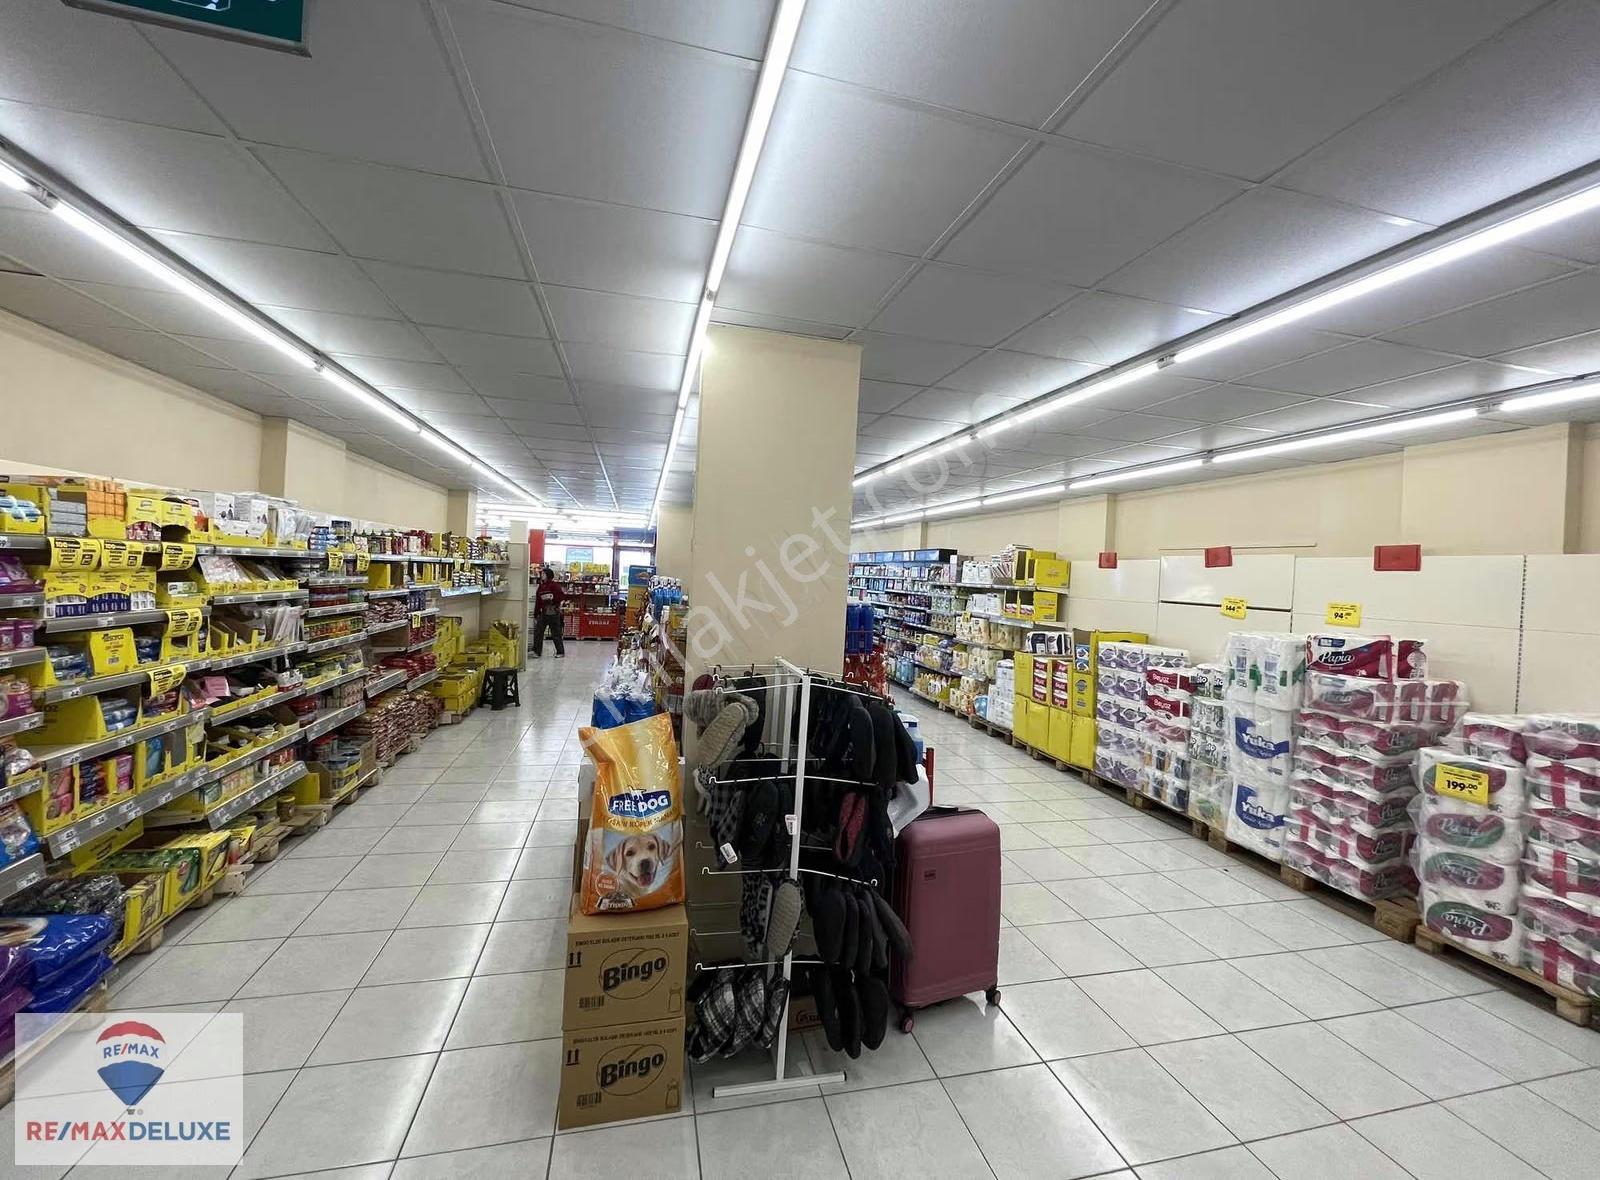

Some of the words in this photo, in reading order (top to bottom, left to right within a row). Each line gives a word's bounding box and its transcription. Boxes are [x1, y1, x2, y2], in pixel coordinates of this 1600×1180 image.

[1321, 652, 1352, 665] Papia
[1241, 733, 1276, 751] Yuka
[1241, 801, 1276, 823] Yuka
[1444, 914, 1488, 936] Papia
[603, 957, 667, 992] Bingo
[600, 1053, 665, 1089] Bingo
